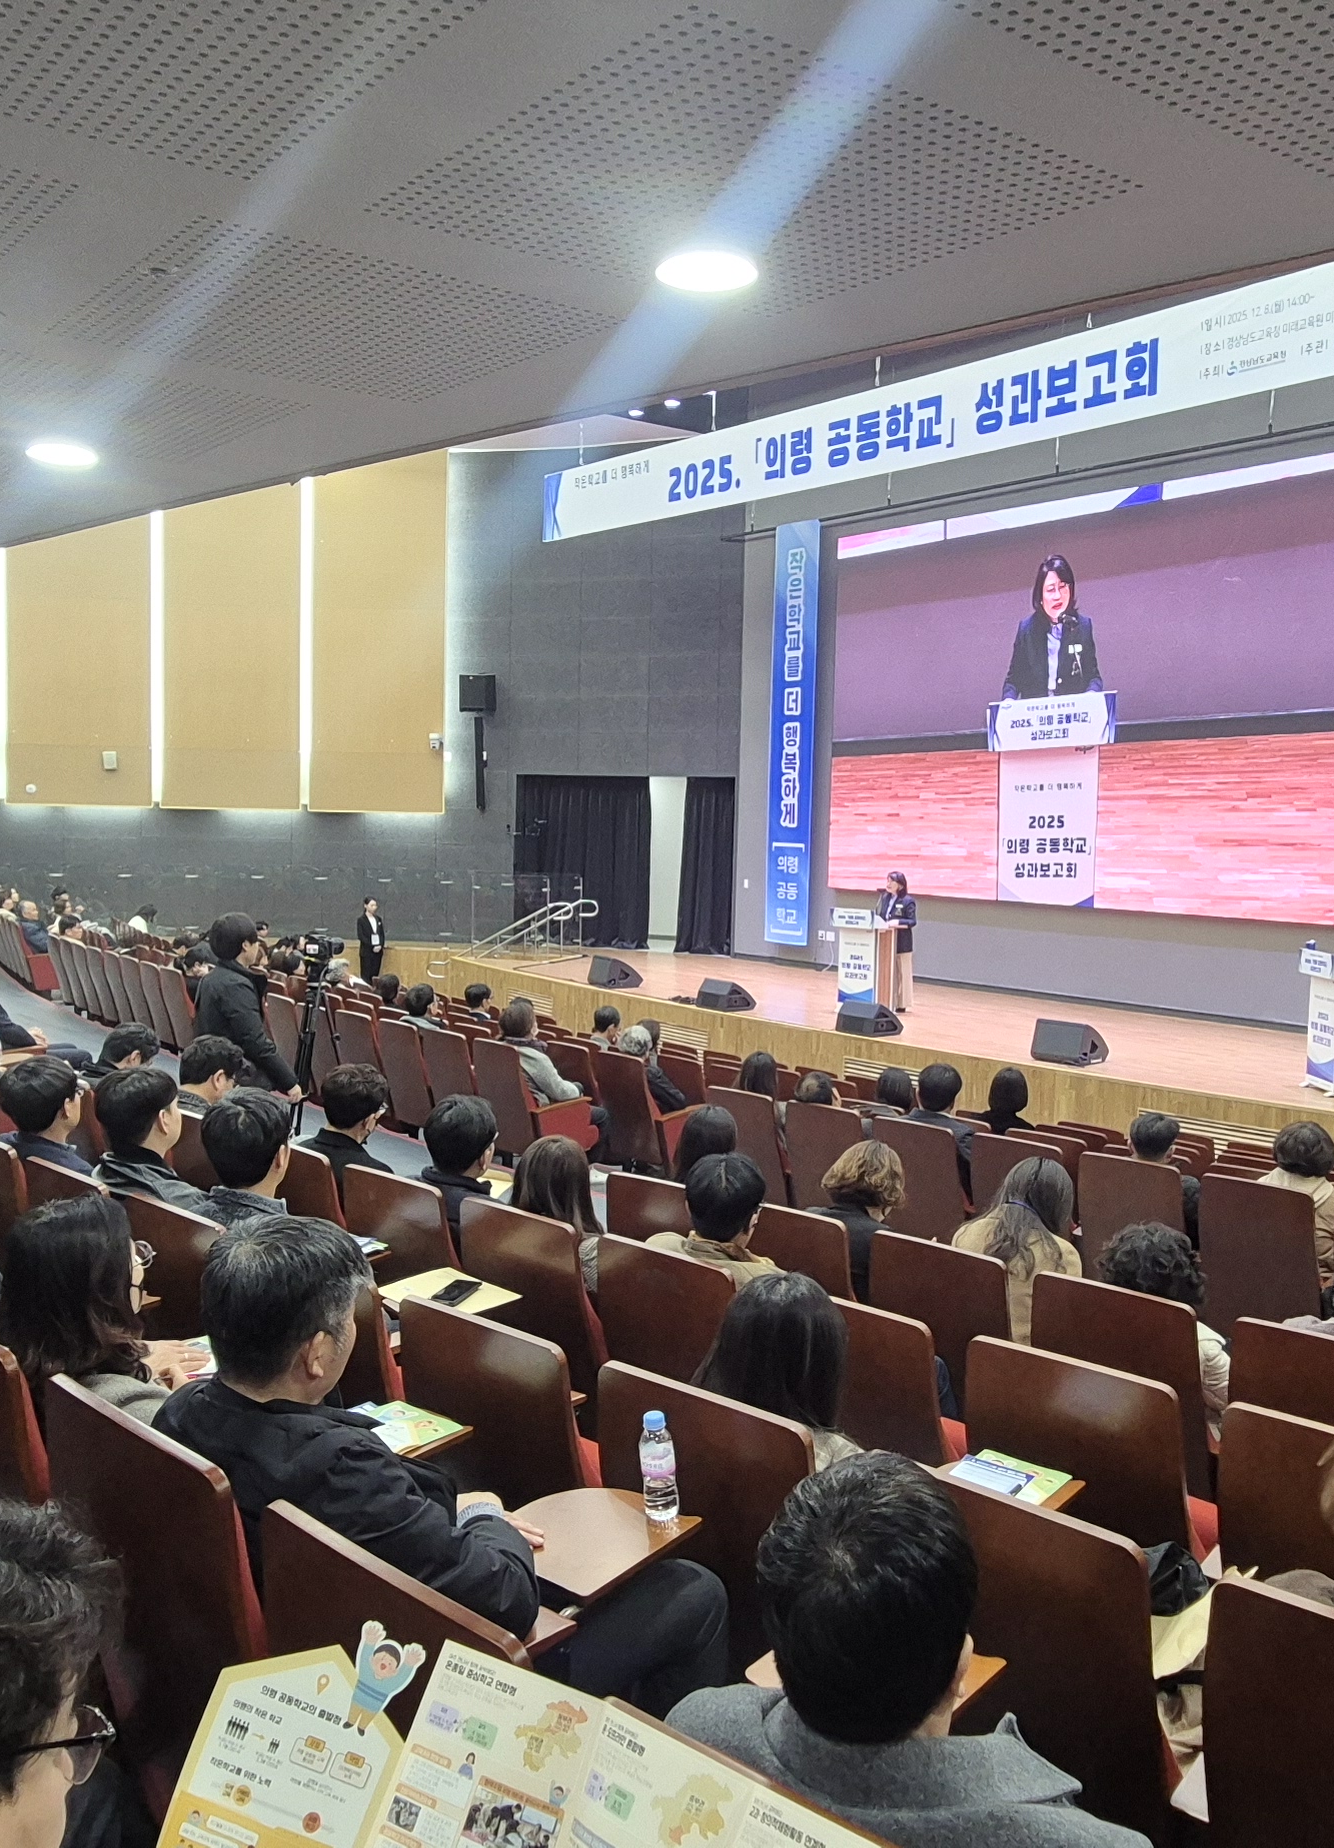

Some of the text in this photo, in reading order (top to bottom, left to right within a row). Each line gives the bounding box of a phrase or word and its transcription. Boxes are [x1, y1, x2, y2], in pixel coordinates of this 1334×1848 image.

[668, 337, 1159, 503] 2025. 「의령 공동학교」 성과보고회
[781, 548, 806, 827] 작은학교를 더 행복하게
[1028, 815, 1065, 829] 2025
[1014, 862, 1077, 878] 성과보고회
[278, 1692, 318, 1716] 공동학교의
